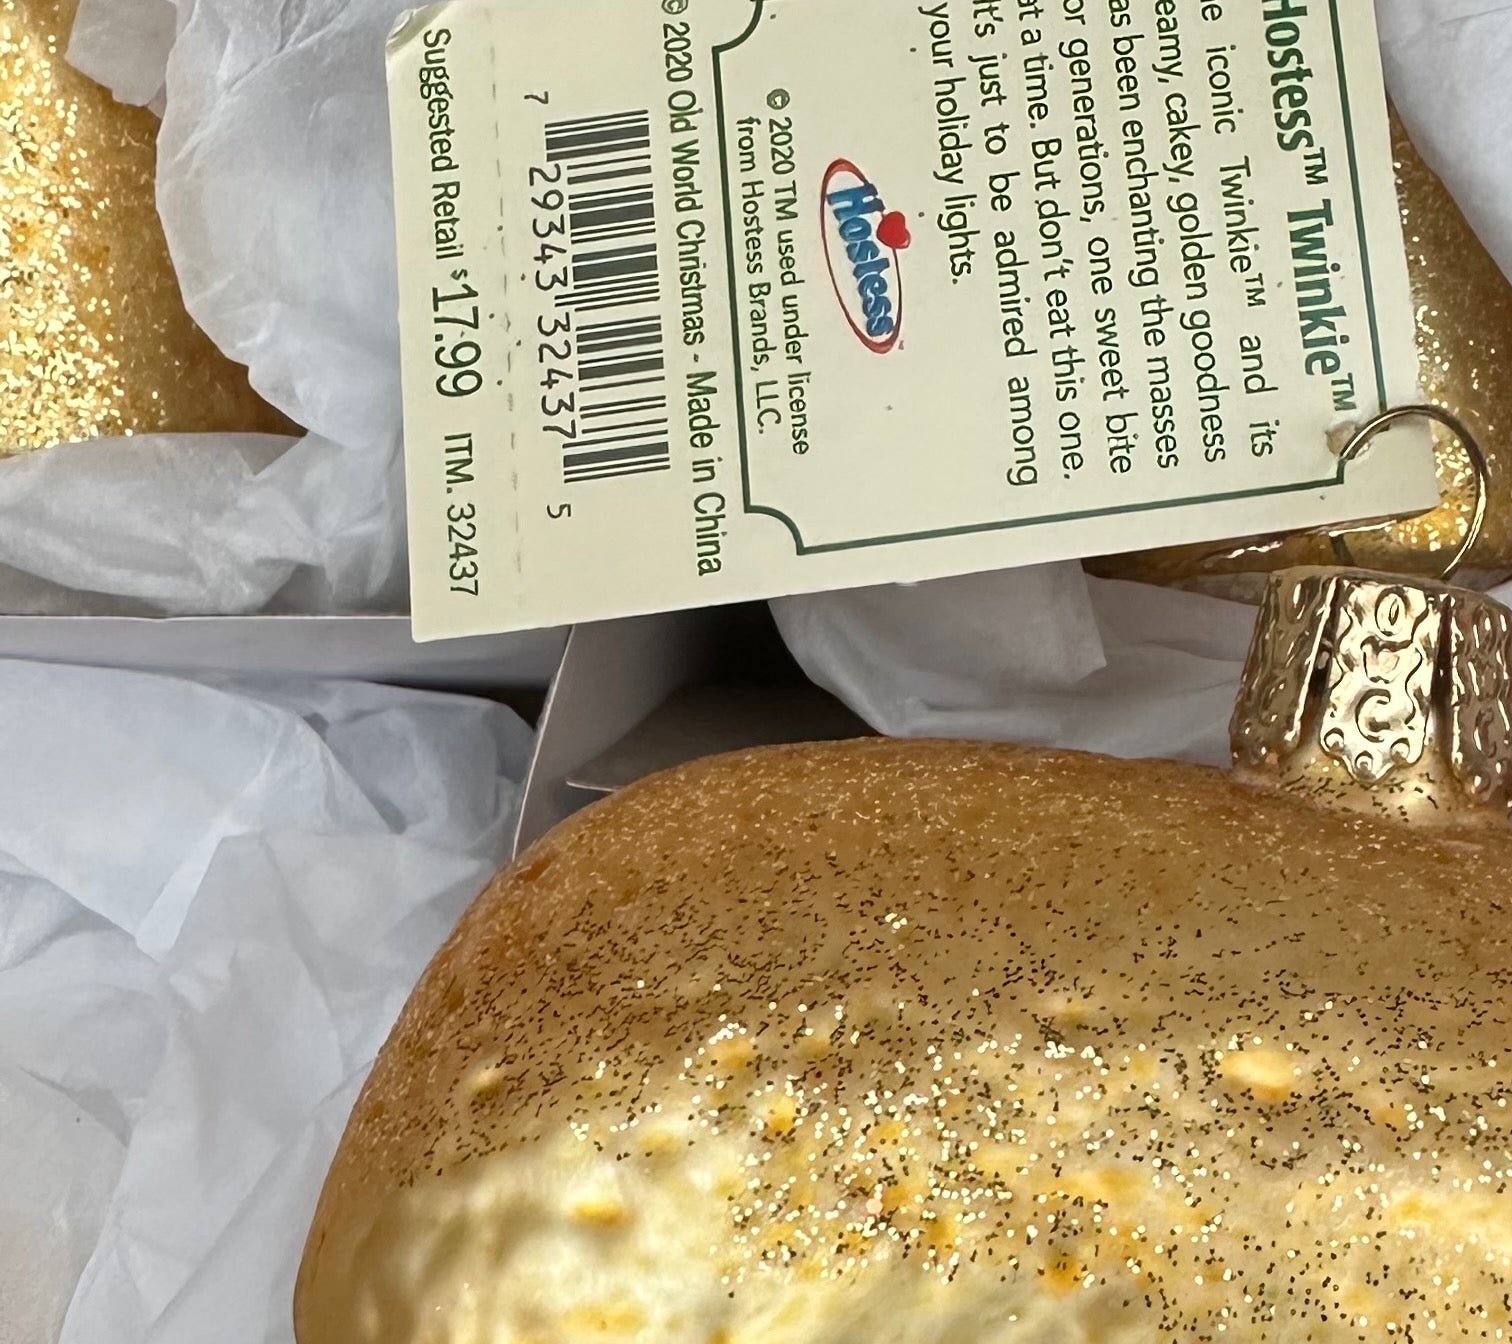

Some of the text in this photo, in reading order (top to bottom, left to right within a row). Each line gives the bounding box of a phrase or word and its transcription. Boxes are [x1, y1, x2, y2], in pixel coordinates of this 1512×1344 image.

[662, 20, 694, 83] 2020
[1019, 28, 1043, 47] a
[1112, 33, 1145, 112] been
[667, 89, 699, 135] Old
[966, 51, 1009, 108] just
[1022, 51, 1055, 130] time.
[1204, 43, 1245, 135] iconic
[767, 116, 796, 176] 2020
[917, 1, 978, 286] your holiday lights.
[983, 120, 1011, 156] to
[1030, 137, 1063, 193] But
[1058, 37, 1110, 224] generations,
[1162, 91, 1201, 184] cakey,
[670, 138, 705, 214] World
[773, 178, 799, 222] TM
[988, 170, 1021, 213] be
[1121, 119, 1166, 289] enchanting
[735, 115, 782, 435] from Hostess Brands, LLC.
[776, 228, 806, 287] used
[824, 182, 895, 339] Hostess
[1036, 200, 1075, 283] don't
[1086, 235, 1114, 296] one
[1166, 191, 1215, 301] golden
[416, 27, 484, 597] Suggested Retail $17.99 ITM. 32437
[523, 90, 578, 520] 7 29343 32437 5
[675, 218, 708, 347] Christmas
[993, 230, 1038, 358] admired
[1045, 288, 1077, 340] eat
[1139, 293, 1175, 348] the
[780, 293, 810, 365] under
[1093, 307, 1131, 403] sweet
[1238, 334, 1280, 395] and
[685, 370, 722, 449] Made
[1050, 343, 1086, 403] this
[1145, 355, 1180, 470] masses
[1179, 308, 1230, 464] goodness
[786, 370, 812, 456] license
[1005, 375, 1039, 487] among
[1057, 410, 1085, 480] one.
[1104, 411, 1140, 475] bite
[1248, 418, 1281, 458] its
[691, 456, 724, 484] in
[692, 491, 728, 577] China
